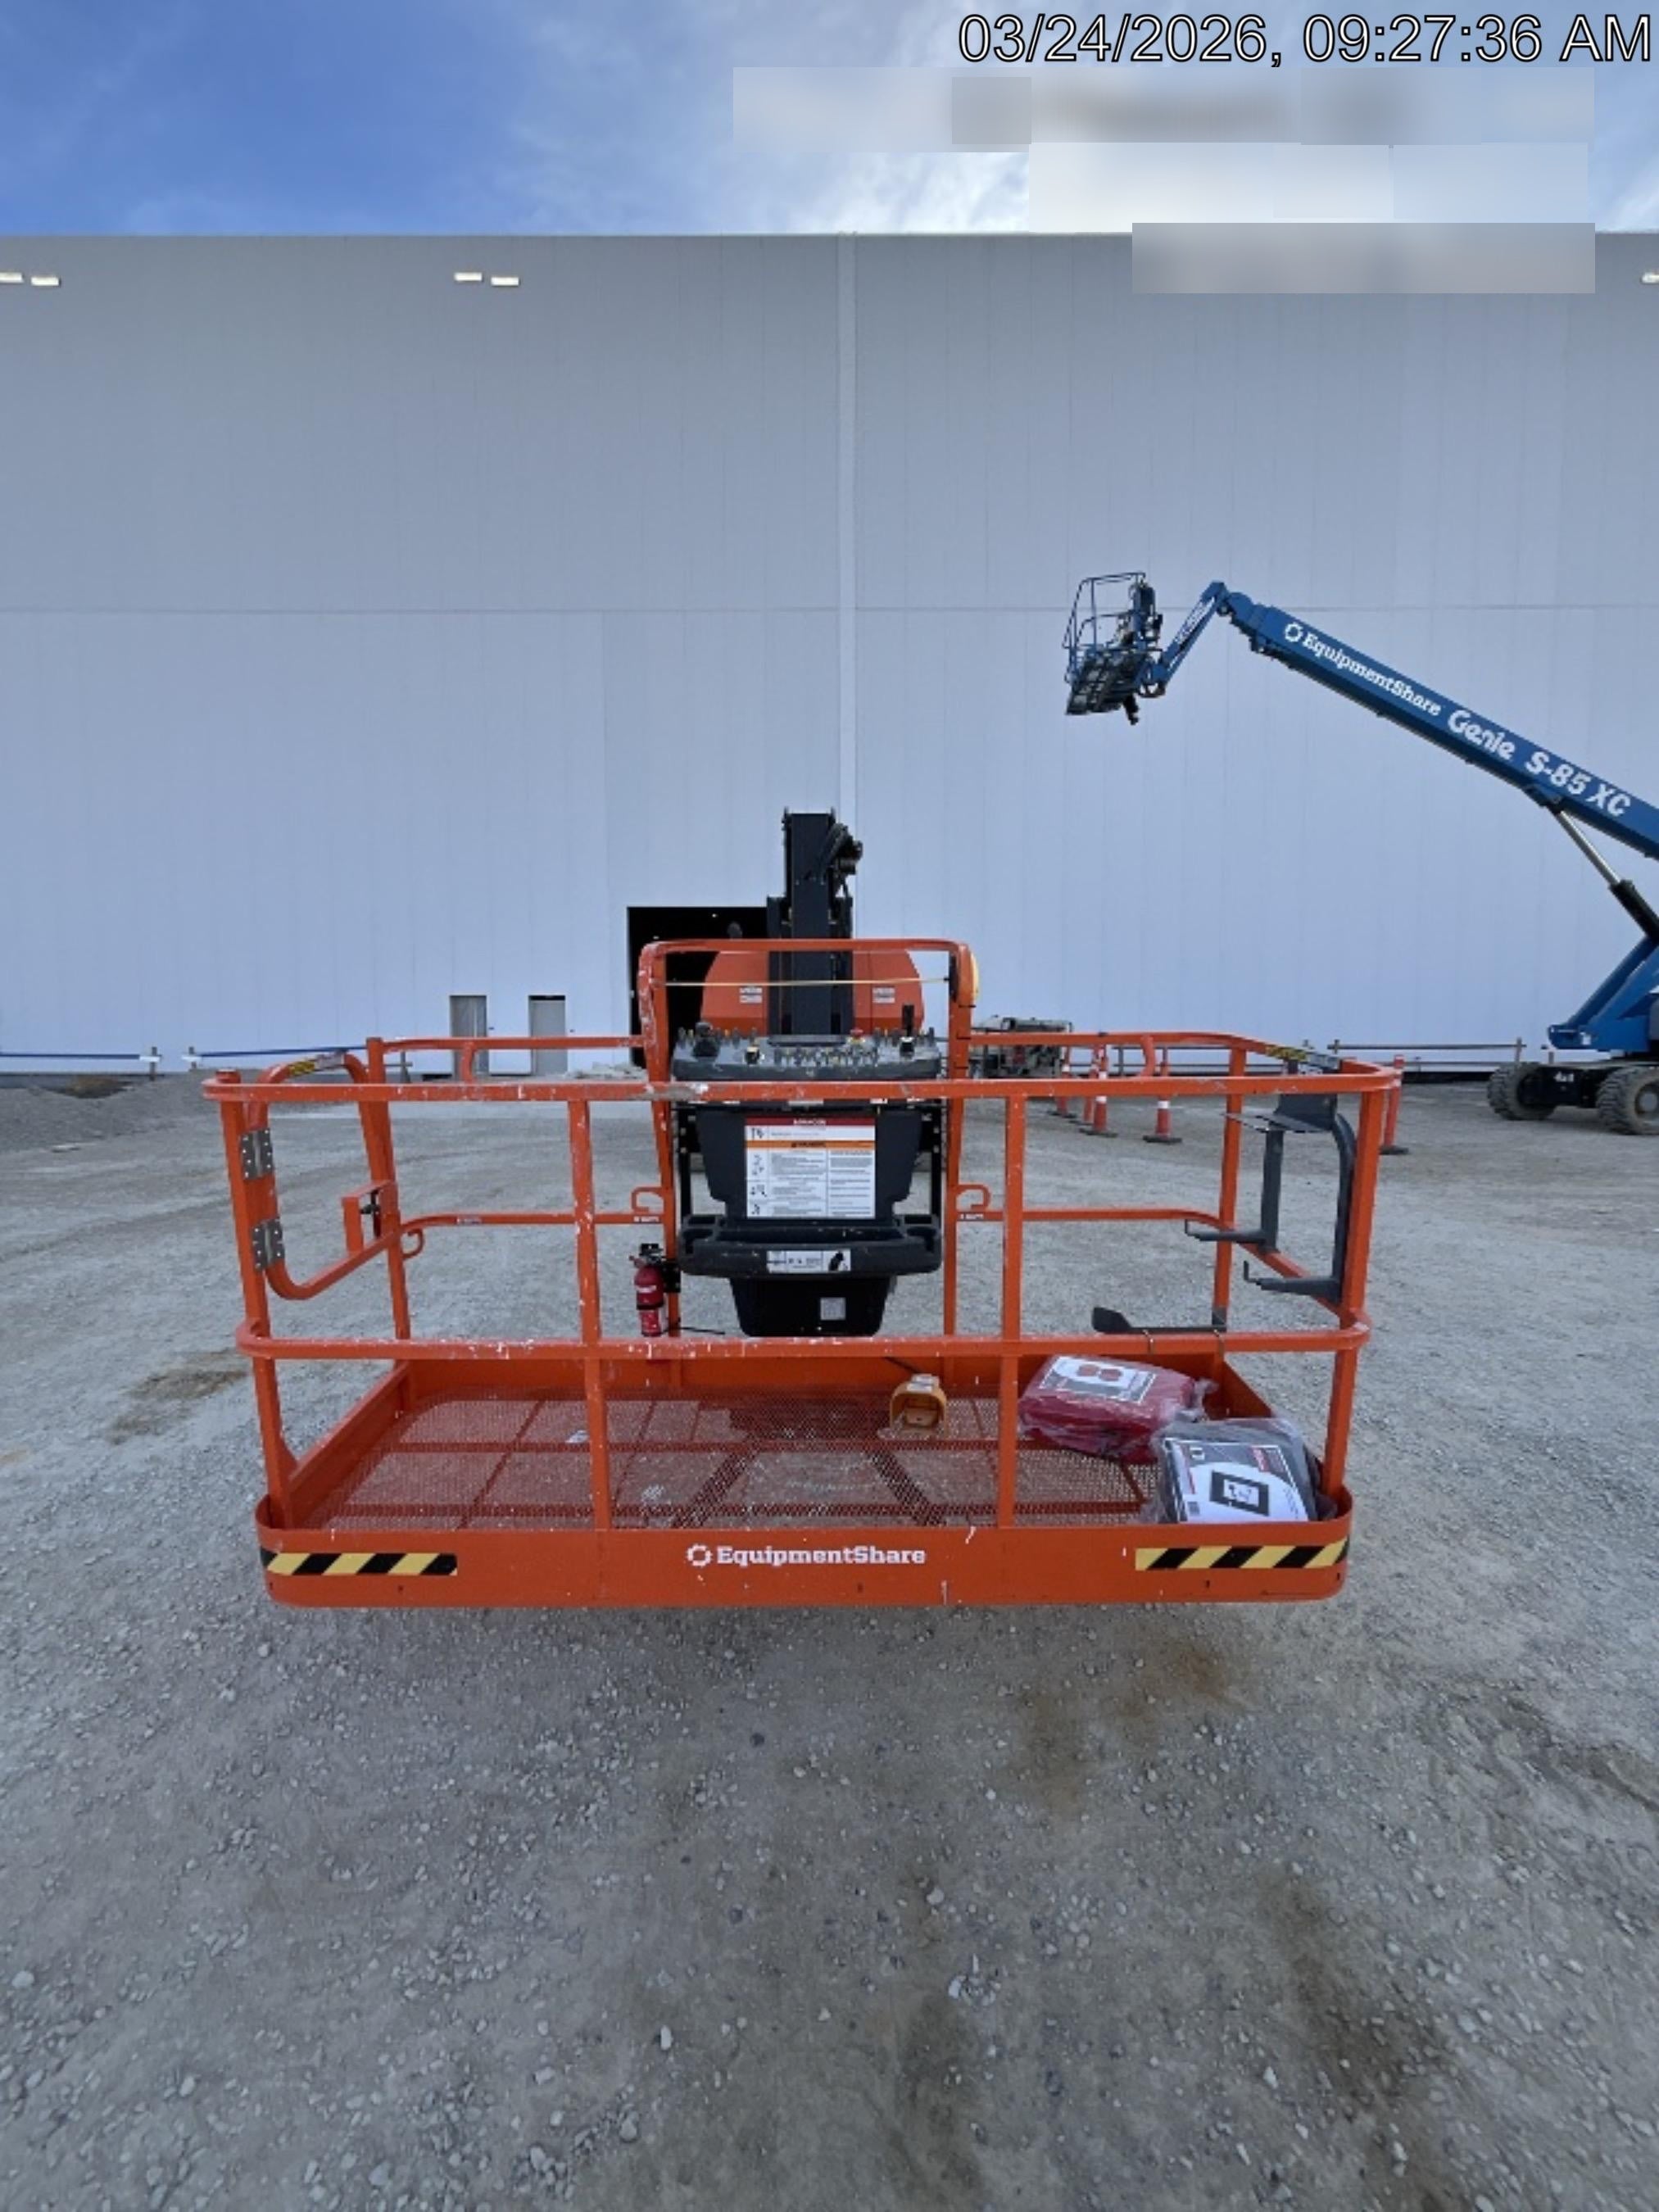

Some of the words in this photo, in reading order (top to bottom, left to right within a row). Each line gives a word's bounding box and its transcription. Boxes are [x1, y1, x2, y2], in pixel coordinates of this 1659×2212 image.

[1303, 632, 1441, 716] EquipmentShare
[1448, 709, 1515, 760] Genie
[1525, 751, 1591, 795] S-85
[1586, 783, 1631, 816] XC
[717, 1546, 926, 1567] EquipmentShare
